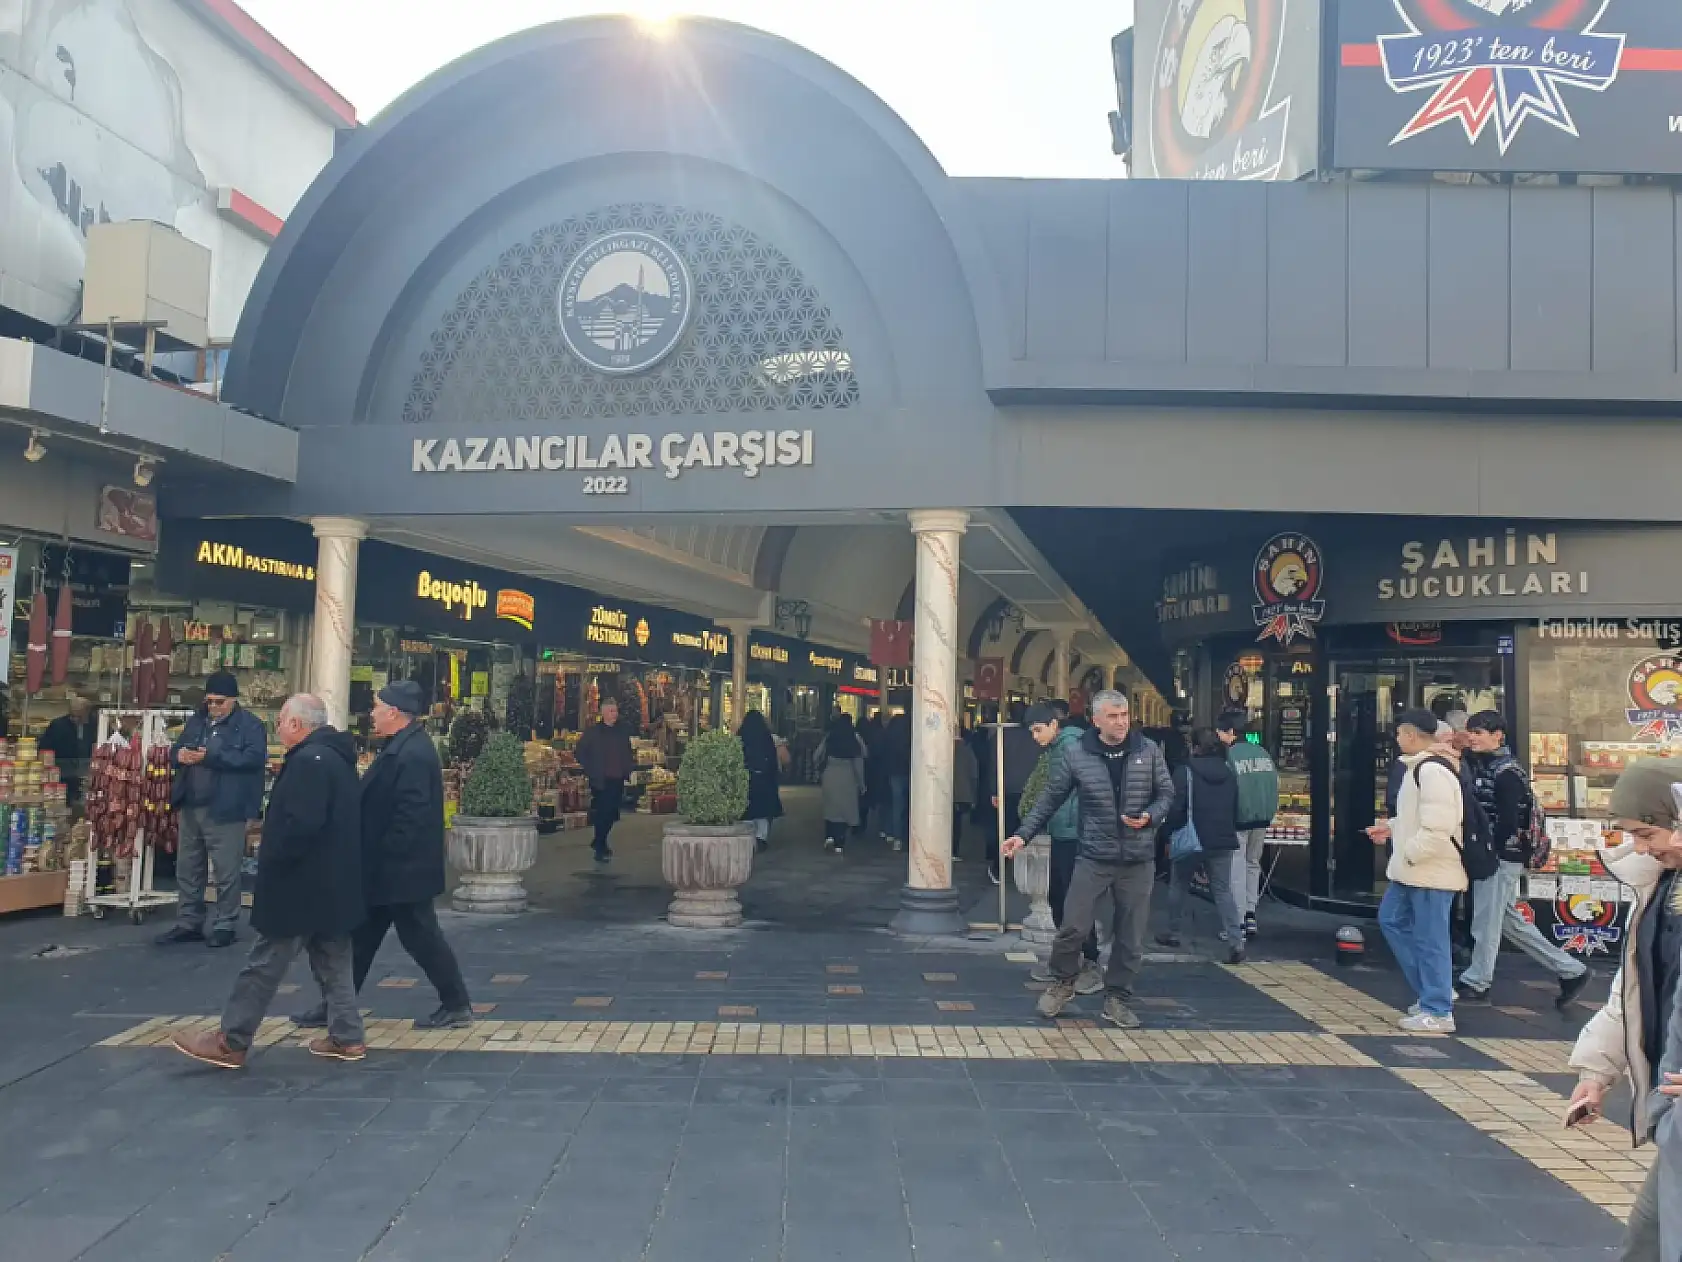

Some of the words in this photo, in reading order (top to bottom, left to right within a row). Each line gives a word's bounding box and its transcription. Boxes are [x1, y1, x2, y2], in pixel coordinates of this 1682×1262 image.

[1412, 36, 1483, 72] 1923'
[1488, 37, 1534, 61] ten
[1541, 37, 1596, 71] beri
[411, 433, 655, 473] KAZANCILAR
[660, 429, 813, 479] ÇARŞISI
[582, 476, 629, 495] 2022
[197, 540, 244, 569] AKM
[1401, 527, 1557, 574] ŞAHİN
[1377, 571, 1589, 599] SUCUKLARI
[1538, 617, 1619, 639] Fabrika
[1626, 617, 1681, 645] Satış
